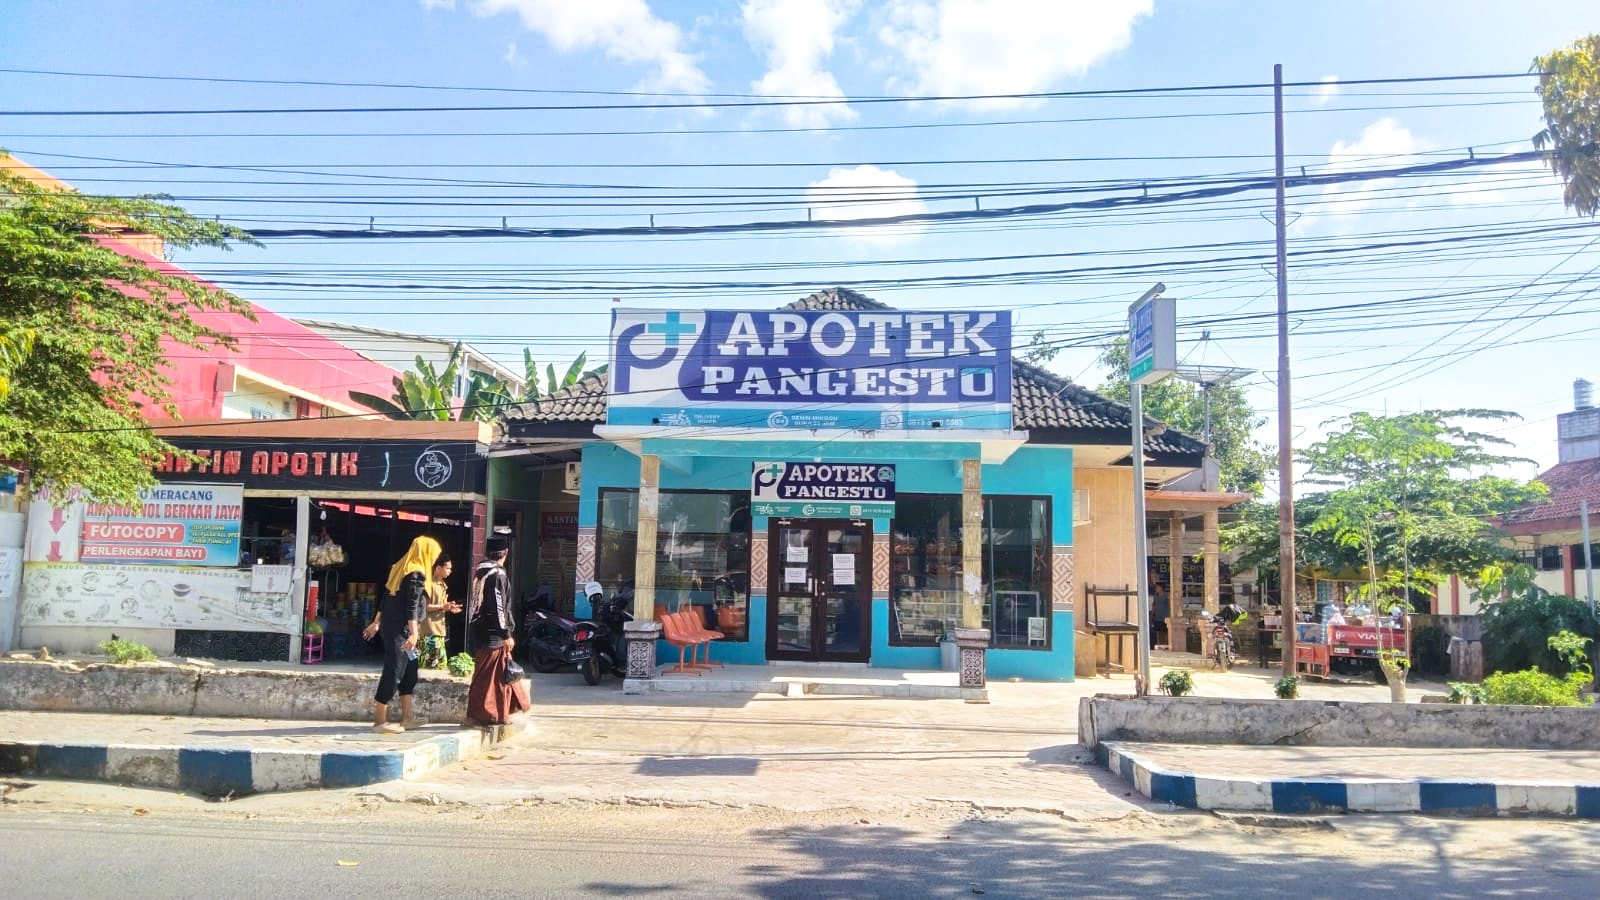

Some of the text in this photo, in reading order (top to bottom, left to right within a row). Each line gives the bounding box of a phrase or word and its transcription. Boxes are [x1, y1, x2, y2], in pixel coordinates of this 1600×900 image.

[717, 312, 998, 357] APOTEK
[251, 451, 360, 477] APOTIK
[789, 464, 875, 483] APOTEK
[152, 488, 214, 502] MERACANG
[163, 504, 212, 519] BERKAH
[214, 504, 242, 520] JAYA
[90, 523, 179, 540] FOTOCOPY
[83, 546, 203, 560] PERLENGKAPAN BAYI
